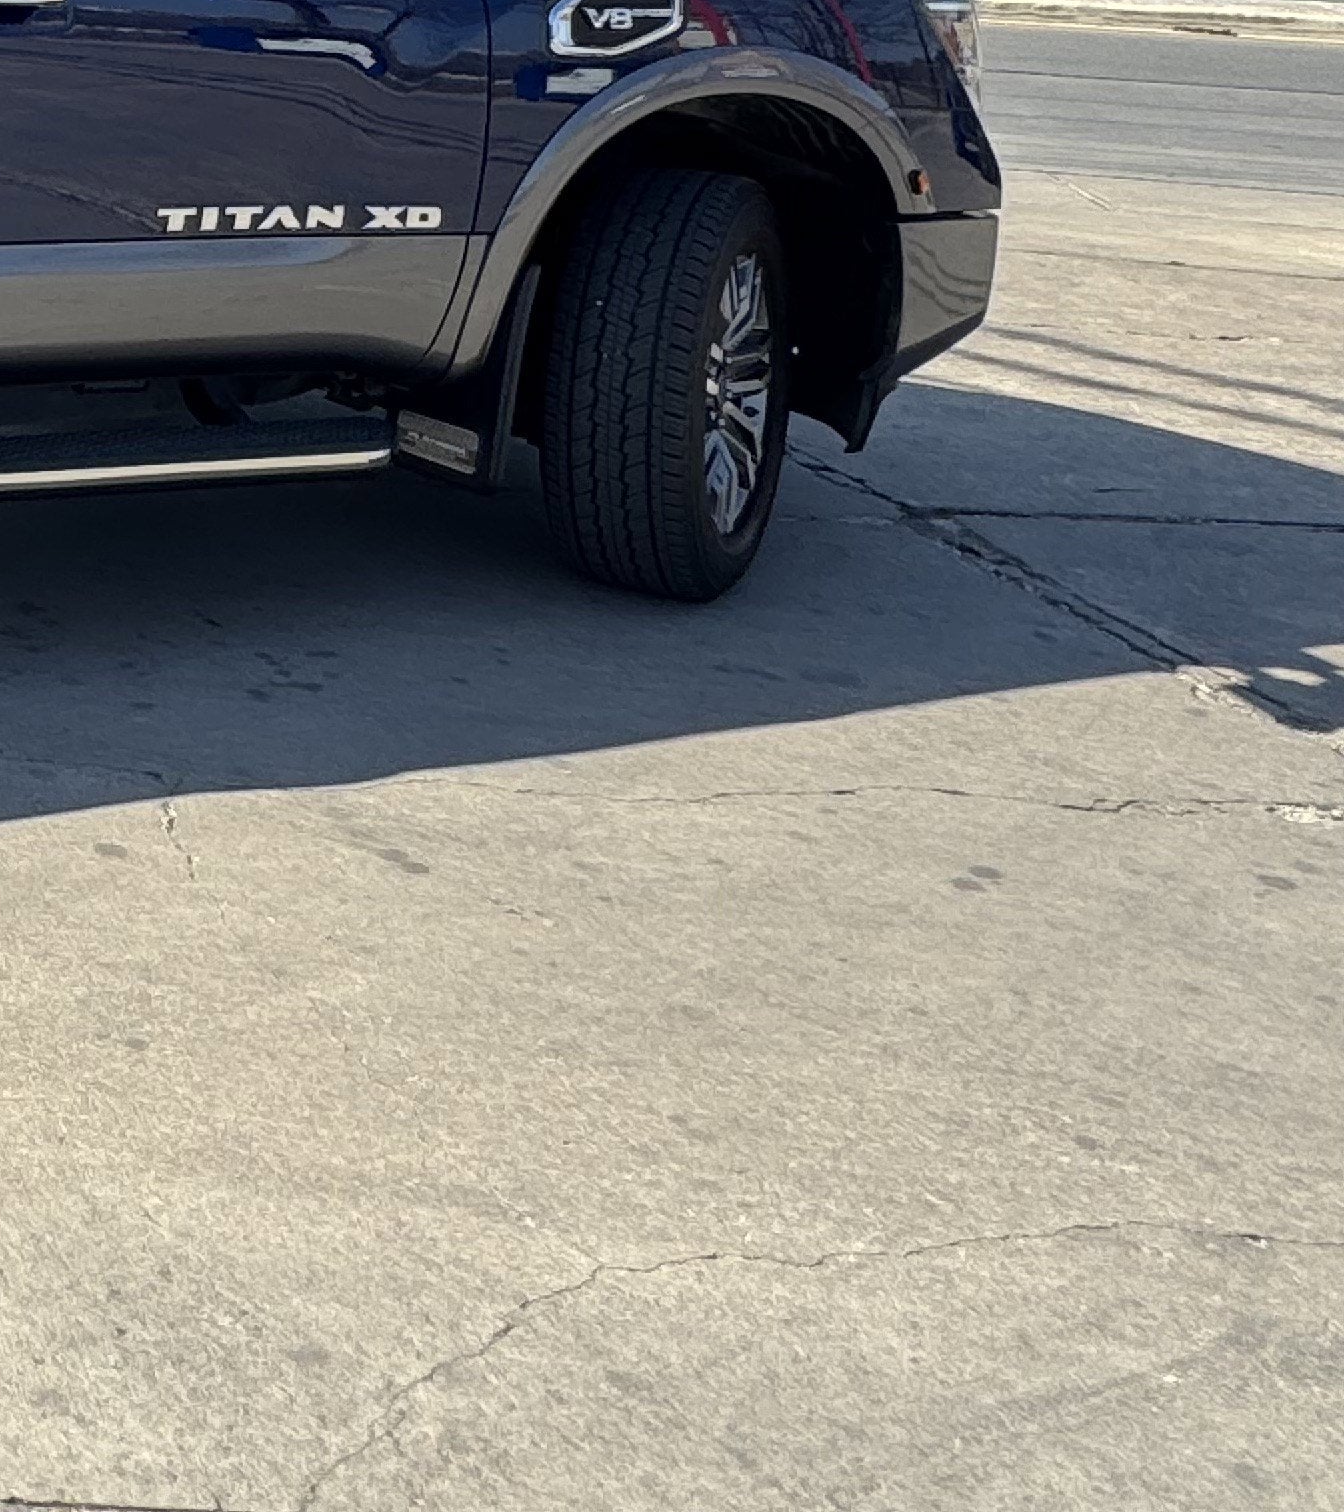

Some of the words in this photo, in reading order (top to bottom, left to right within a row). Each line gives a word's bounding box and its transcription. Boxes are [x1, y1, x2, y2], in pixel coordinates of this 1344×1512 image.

[583, 7, 634, 30] V8
[157, 205, 345, 232] TITAN
[362, 205, 442, 229] XD
